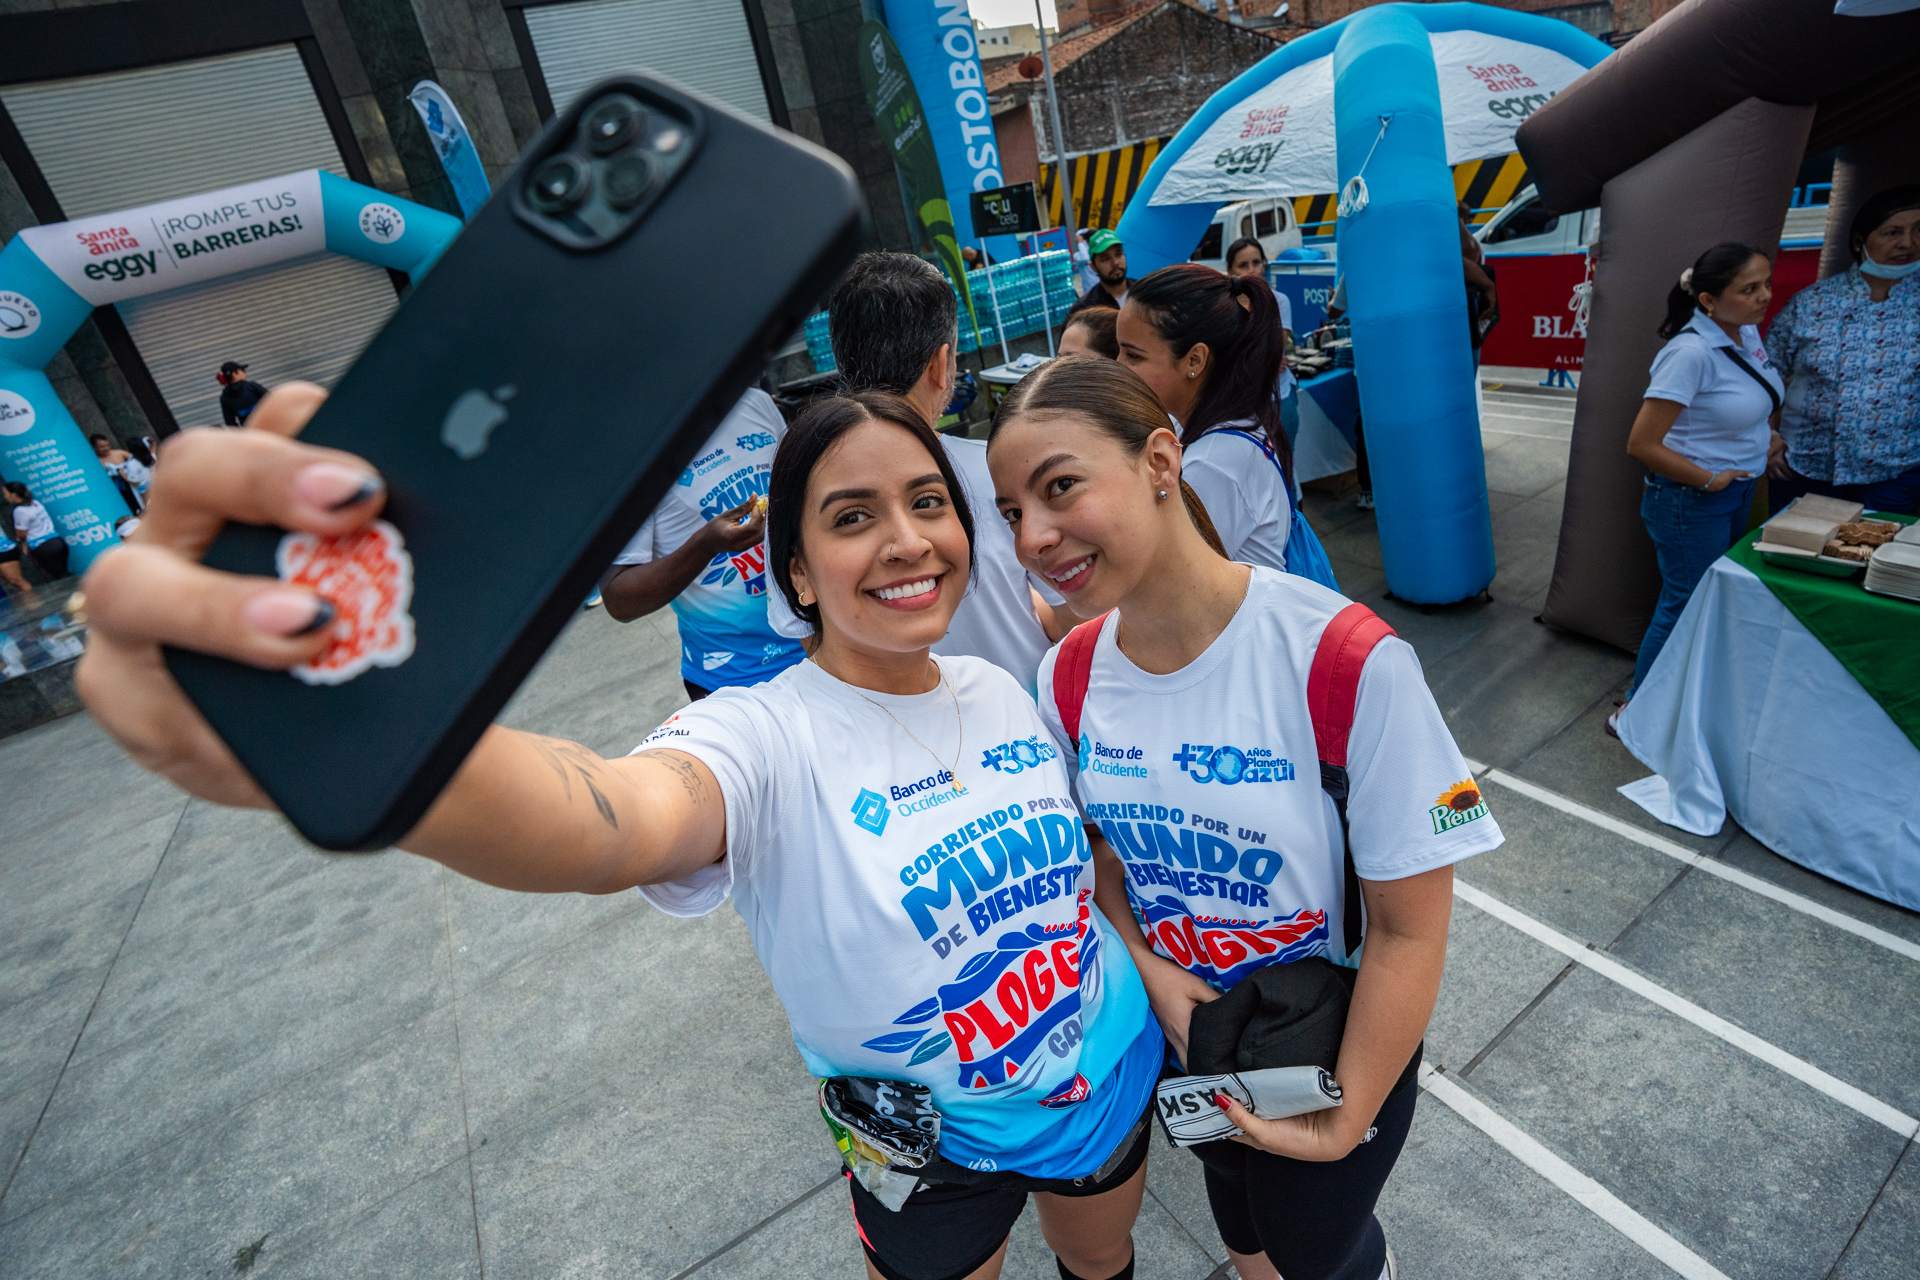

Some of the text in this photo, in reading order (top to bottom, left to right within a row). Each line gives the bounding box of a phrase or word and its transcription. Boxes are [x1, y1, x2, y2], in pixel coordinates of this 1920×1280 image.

[1465, 63, 1522, 80] Santa
[1484, 75, 1538, 92] anita
[1247, 104, 1290, 122] Santa
[1239, 120, 1284, 139] anita
[1213, 139, 1285, 176] eggy
[161, 191, 297, 239] ¡ROMPE TUS
[76, 226, 130, 245] Santa
[87, 235, 140, 256] anita
[172, 214, 304, 260] BARRERAS!
[83, 249, 157, 282] eggy
[692, 447, 725, 469] Banco de
[696, 455, 732, 477] Occidente
[699, 465, 755, 508] CORRIENDO
[65, 521, 113, 546] eggy
[1094, 742, 1143, 760] Banco de
[1246, 747, 1272, 758] AÑOS
[1246, 757, 1288, 769] Planeta
[1092, 758, 1148, 778] Occidente
[1172, 743, 1246, 786] +30
[1242, 762, 1296, 784] azul
[890, 769, 954, 801] Banco de
[897, 786, 970, 817] Occidente
[1085, 803, 1267, 845] CORRIENDO POR UN
[899, 803, 1024, 887] CORRIENDO
[1026, 799, 1060, 813] POR
[900, 813, 1093, 942] MUNDO
[1126, 862, 1269, 908] BIENESTAR
[931, 923, 969, 960] DE
